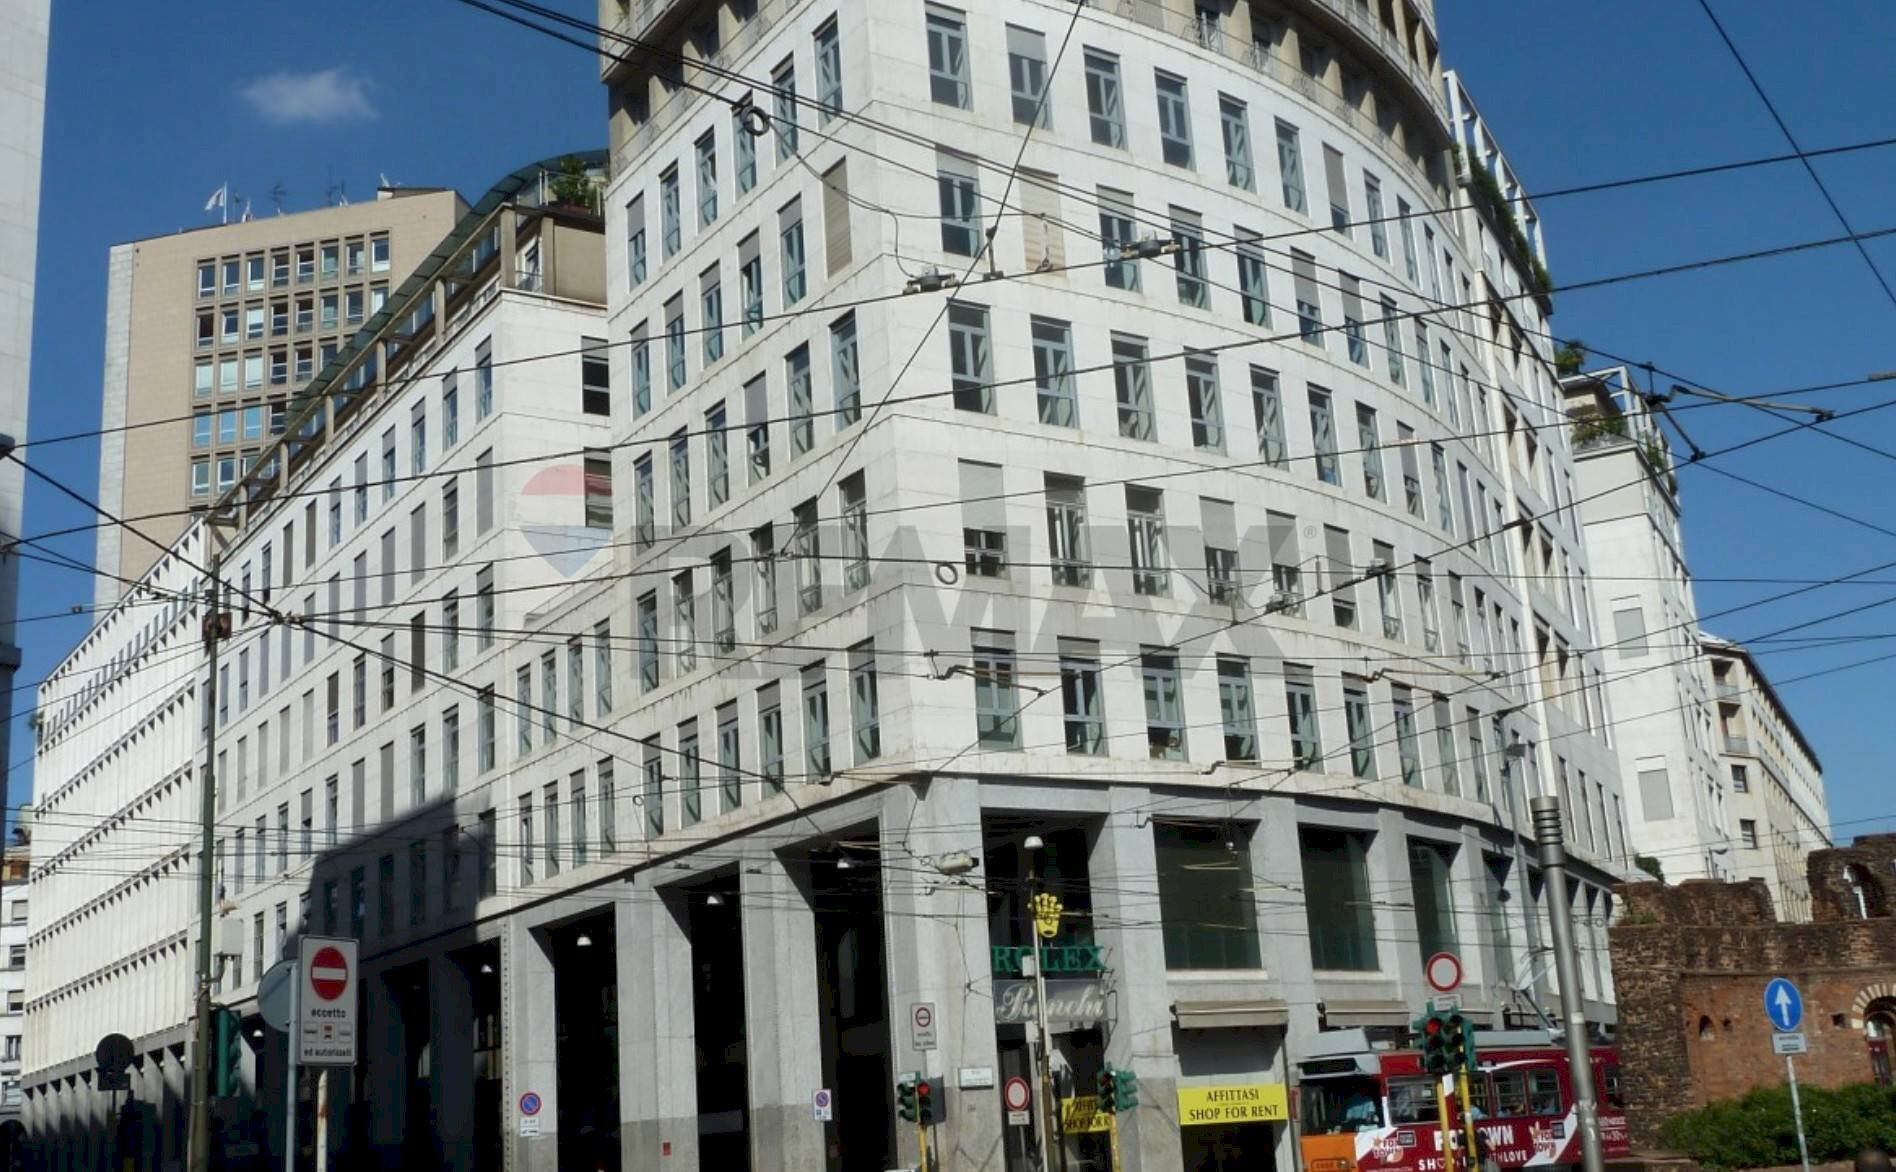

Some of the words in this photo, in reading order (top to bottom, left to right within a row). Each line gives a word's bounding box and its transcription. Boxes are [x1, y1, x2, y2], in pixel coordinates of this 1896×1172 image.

[1206, 1088, 1259, 1102] AFFITTASI
[1189, 1108, 1220, 1120] SHOP
[1225, 1106, 1248, 1119] FOR
[1251, 1104, 1279, 1117] RENT
